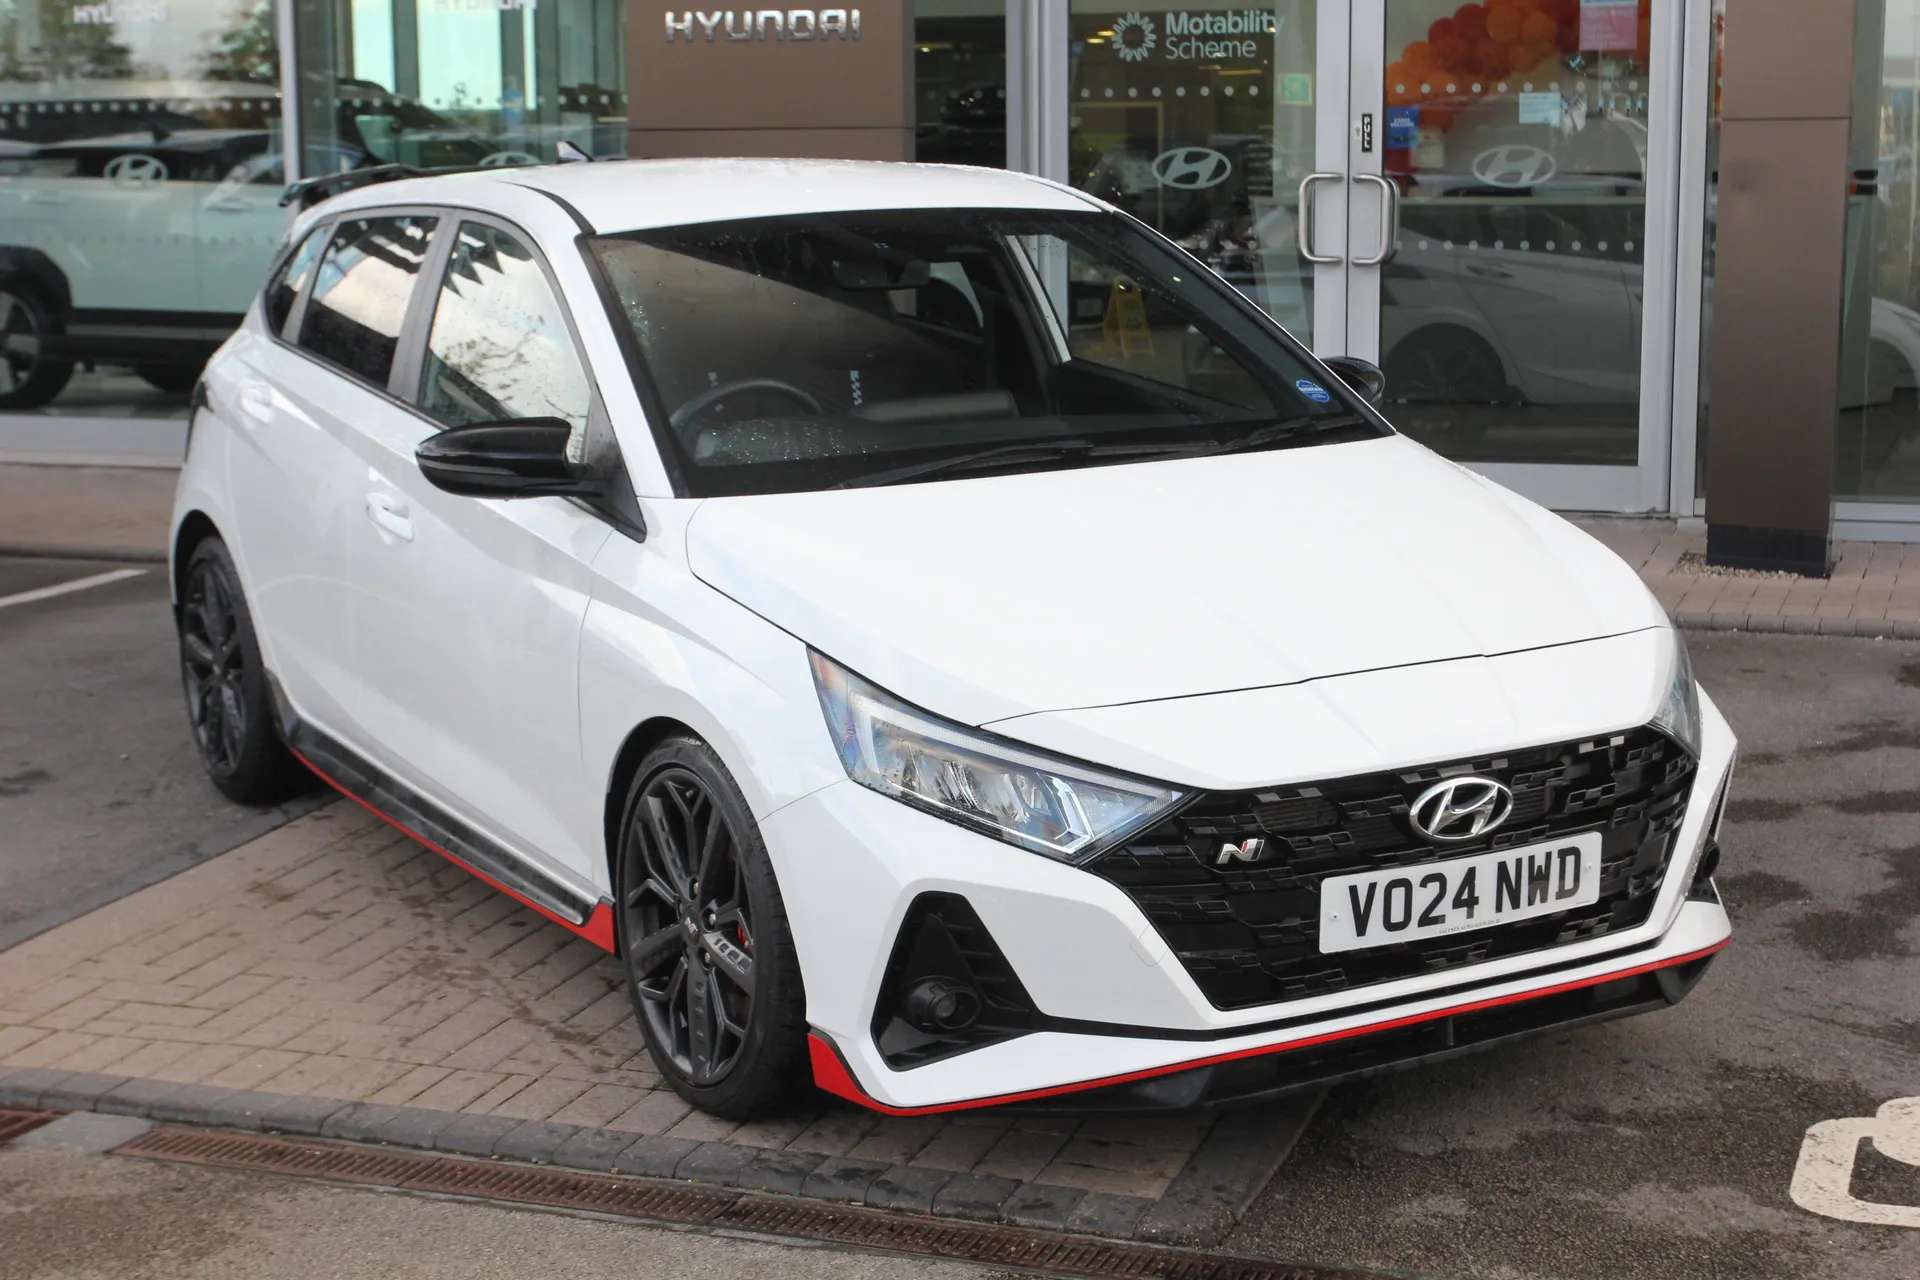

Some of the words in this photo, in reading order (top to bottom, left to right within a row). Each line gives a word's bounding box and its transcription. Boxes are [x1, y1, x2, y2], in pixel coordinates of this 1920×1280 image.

[664, 9, 861, 43] HYUNDAI
[1164, 10, 1284, 38] Motability
[1164, 36, 1257, 60] Scheme
[1348, 865, 1480, 937] VO24
[1494, 846, 1582, 914] NWD
